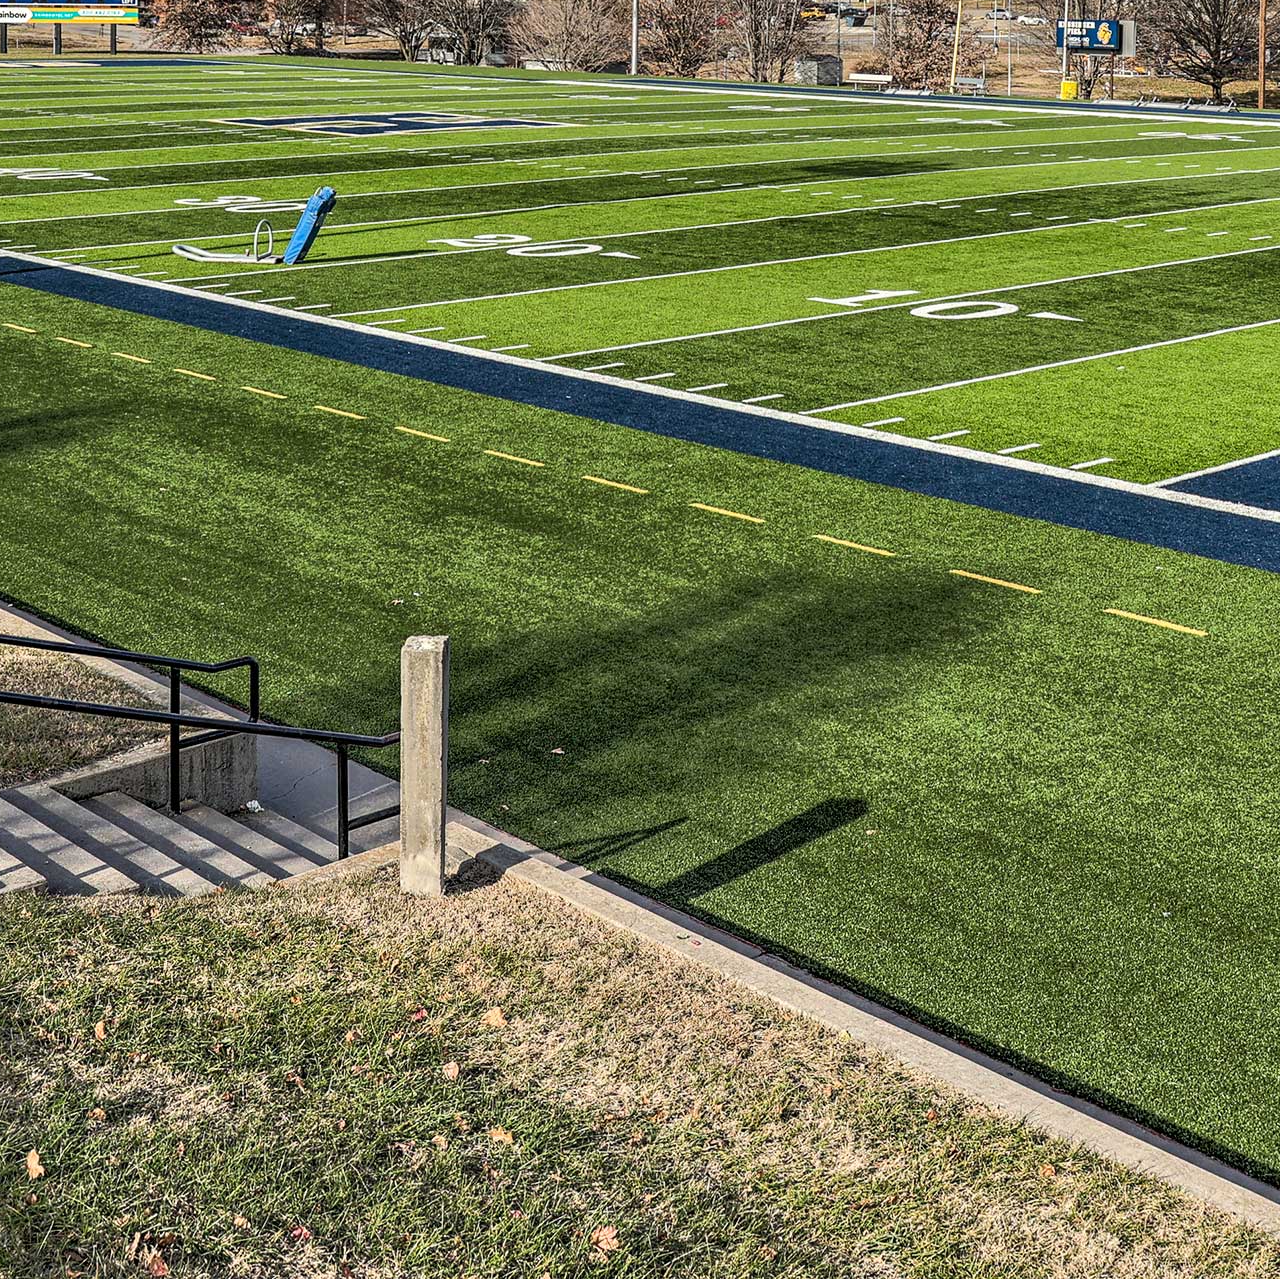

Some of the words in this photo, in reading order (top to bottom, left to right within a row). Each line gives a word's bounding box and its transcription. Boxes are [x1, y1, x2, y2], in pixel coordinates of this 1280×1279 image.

[173, 195, 307, 213] 30
[426, 233, 603, 257] 20
[807, 288, 1019, 320] 10
